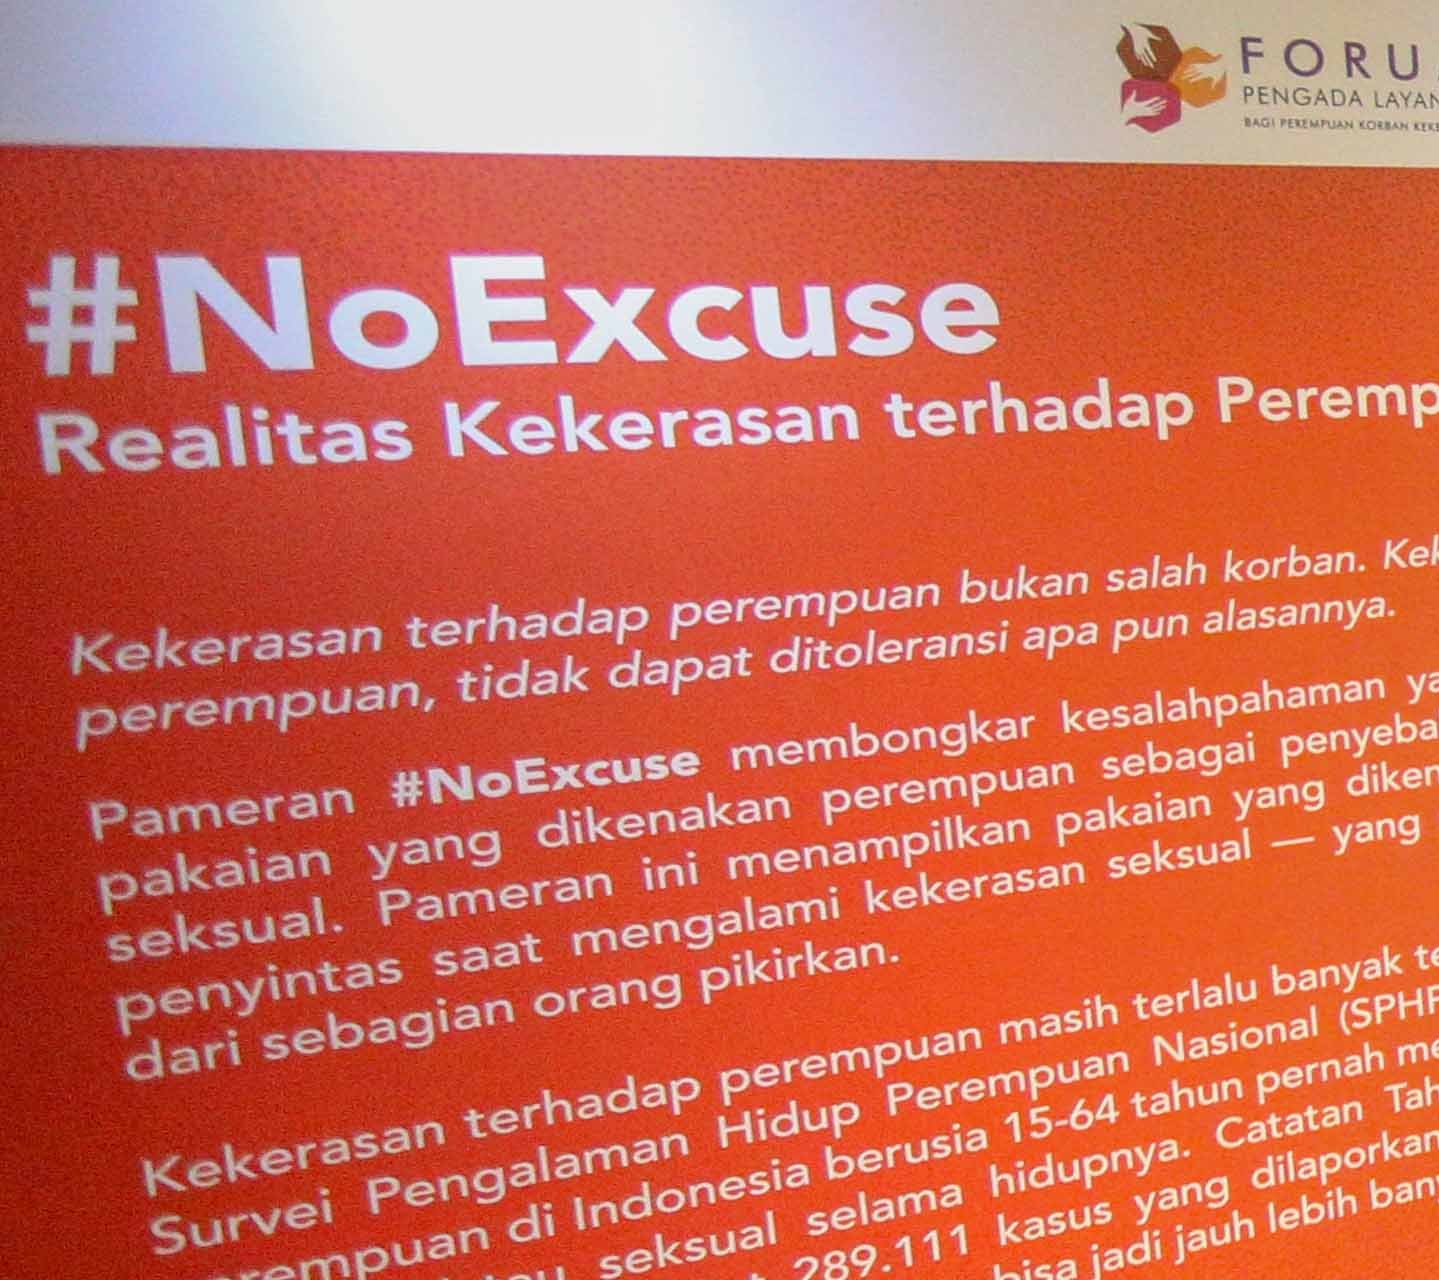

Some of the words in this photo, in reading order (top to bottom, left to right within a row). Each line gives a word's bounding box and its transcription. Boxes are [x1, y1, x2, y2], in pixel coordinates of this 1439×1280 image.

[1243, 86, 1363, 107] PENGADA
[1244, 117, 1276, 129] BAGI
[1280, 118, 1354, 131] PEREMPUAN
[1359, 121, 1410, 132] KORBAN
[26, 252, 999, 377] #NoExcuse
[35, 404, 414, 476] Realitas
[444, 394, 860, 458] Kekerasan
[882, 376, 1195, 441] terhadap
[69, 624, 383, 676] Kekerasan
[405, 596, 650, 649] terhadap
[669, 582, 941, 640] perempuan
[957, 564, 1089, 604] bukan
[1104, 552, 1207, 592] salah
[1222, 544, 1366, 583] korban.
[75, 680, 436, 752] perempuan,
[456, 655, 589, 703] tidak
[607, 646, 753, 696] dapat
[768, 620, 1009, 674] ditoleransi
[1021, 621, 1099, 660] apa
[1110, 613, 1189, 654] pun
[1200, 596, 1395, 634] alasannya.
[87, 787, 354, 842] Pameran
[390, 750, 701, 808] #NoExcuse
[729, 709, 1036, 771] membongkar
[1059, 677, 1386, 733] kesalahpahaman
[1174, 1209, 1256, 1265] jauh
[1265, 1186, 1359, 1233] lebih
